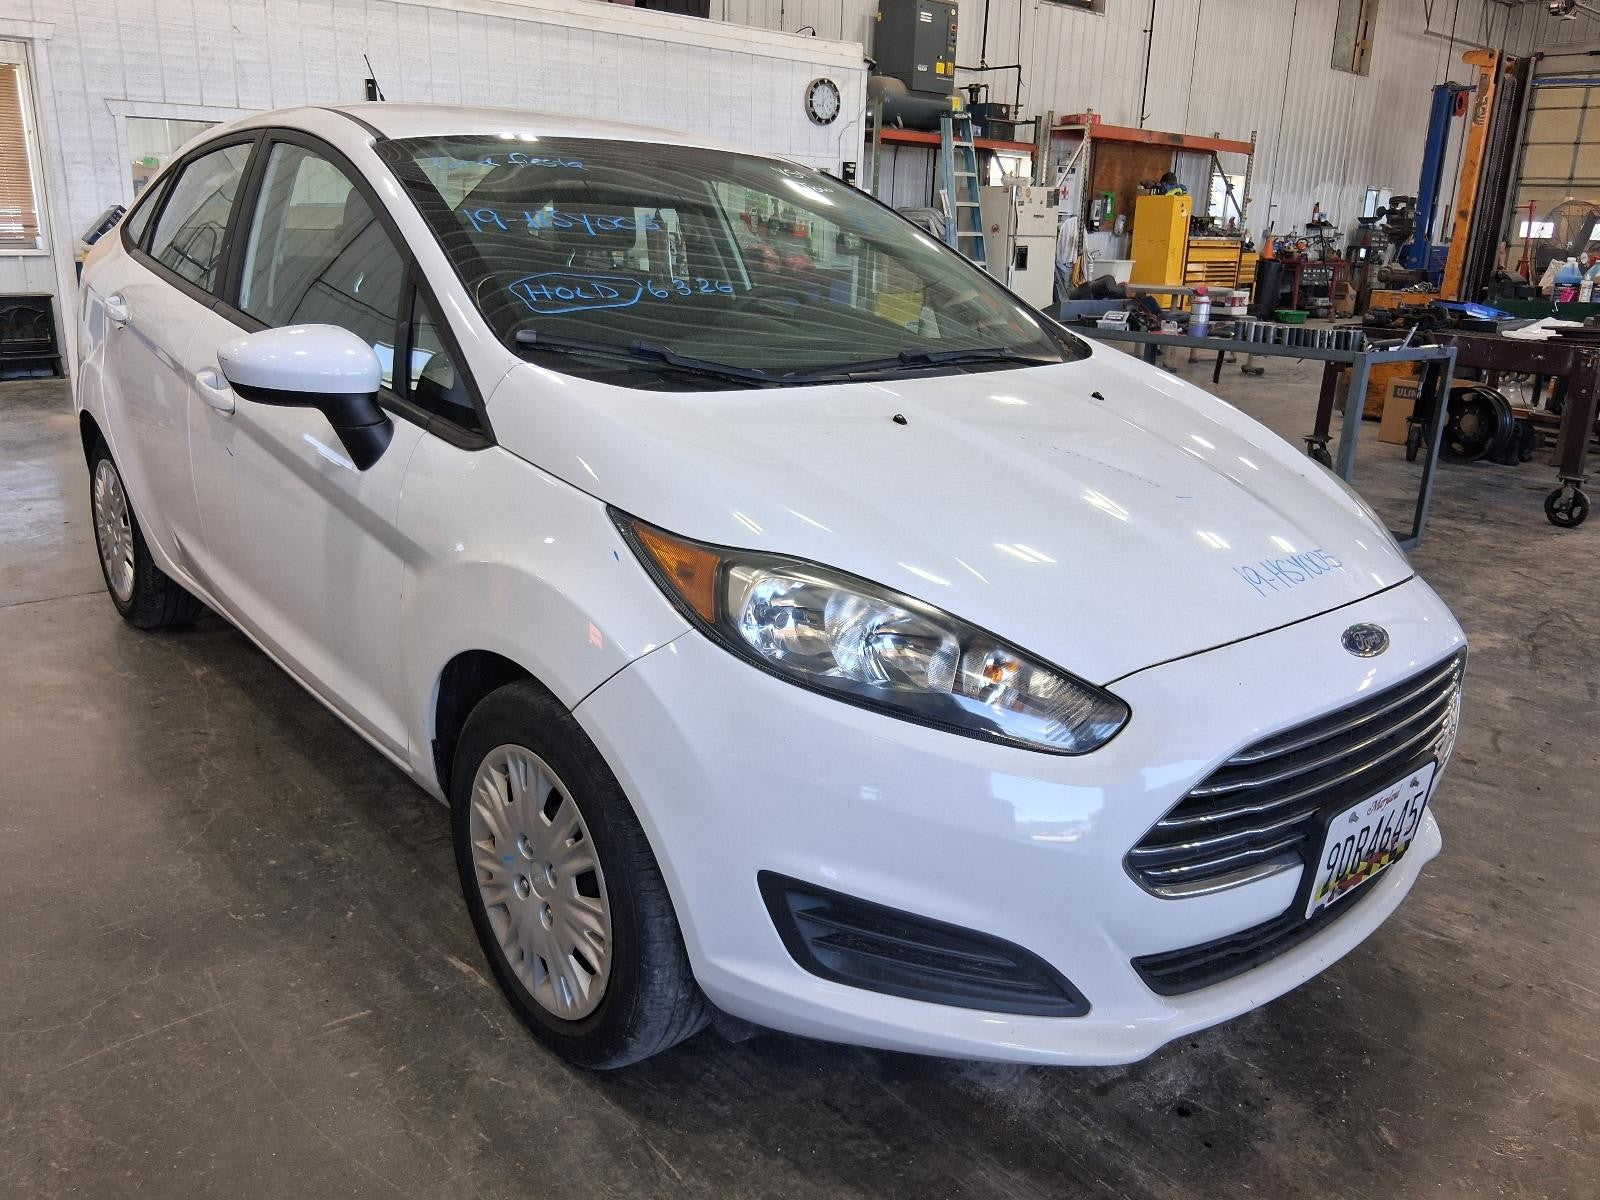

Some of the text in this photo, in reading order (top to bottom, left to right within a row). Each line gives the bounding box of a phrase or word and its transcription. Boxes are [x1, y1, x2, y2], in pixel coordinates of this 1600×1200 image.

[524, 282, 620, 302] HOLD
[1232, 548, 1343, 598] 19-HSY005
[1322, 790, 1424, 890] 9DR4645
